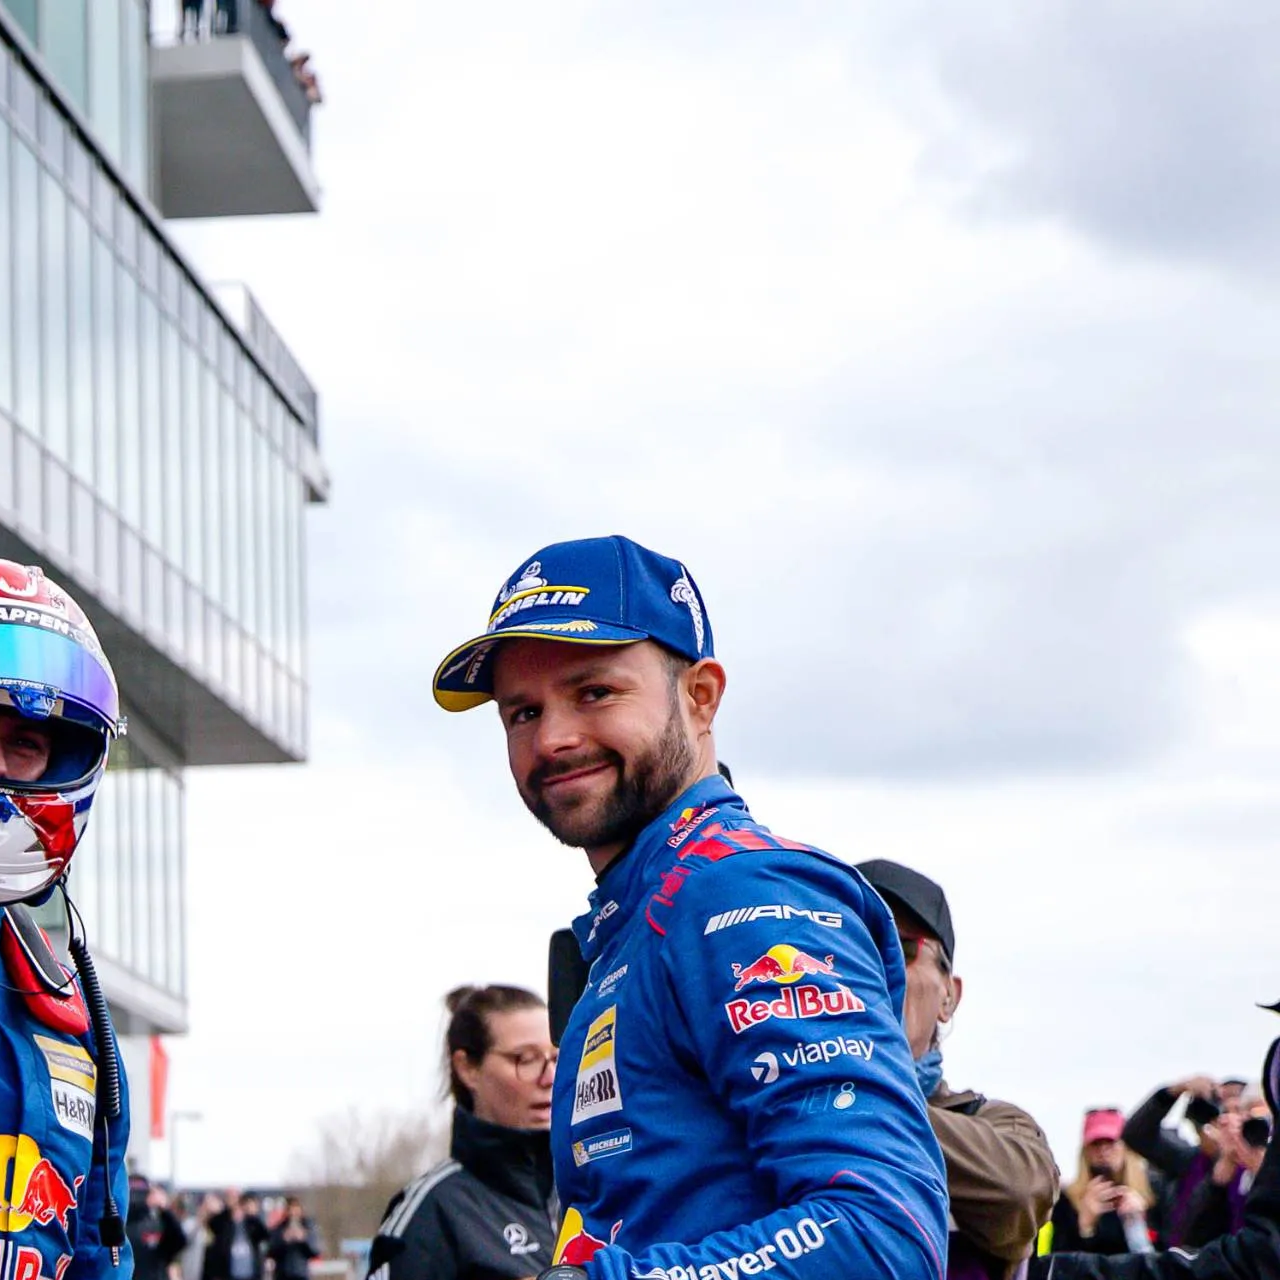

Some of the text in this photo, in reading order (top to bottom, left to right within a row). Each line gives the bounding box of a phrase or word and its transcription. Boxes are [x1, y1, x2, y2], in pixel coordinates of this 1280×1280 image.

[748, 904, 843, 929] AMG
[726, 986, 796, 1034] Red
[781, 1036, 875, 1067] viaplay
[588, 1133, 631, 1153] MICHELIN
[774, 1217, 826, 1261] 0.0
